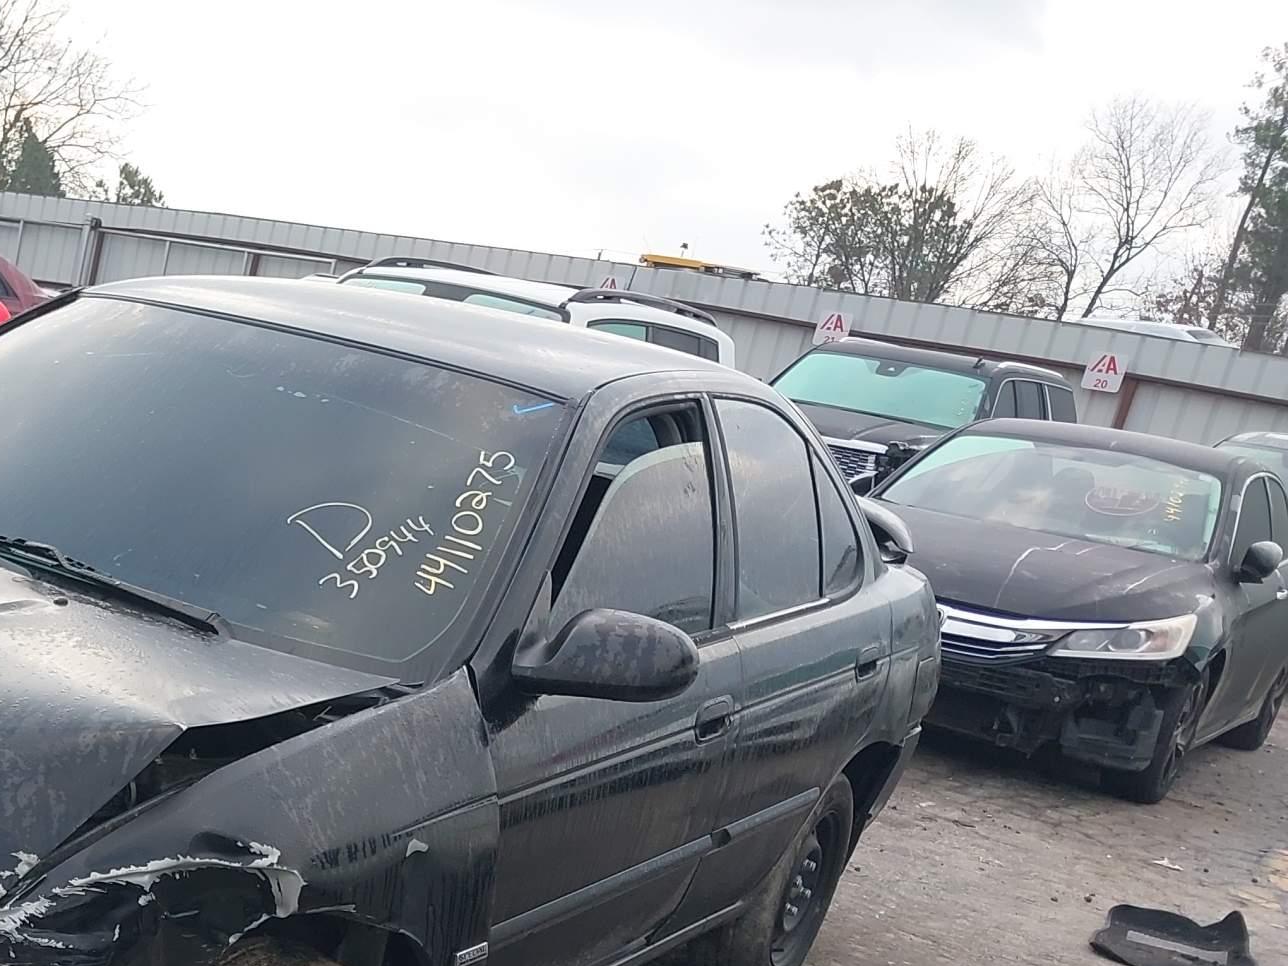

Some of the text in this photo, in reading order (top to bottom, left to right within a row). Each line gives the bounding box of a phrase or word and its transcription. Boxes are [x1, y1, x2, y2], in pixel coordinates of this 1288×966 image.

[1093, 378, 1108, 389] 20
[287, 502, 372, 559] D
[318, 516, 436, 598] 350944
[414, 450, 515, 595] 44110275
